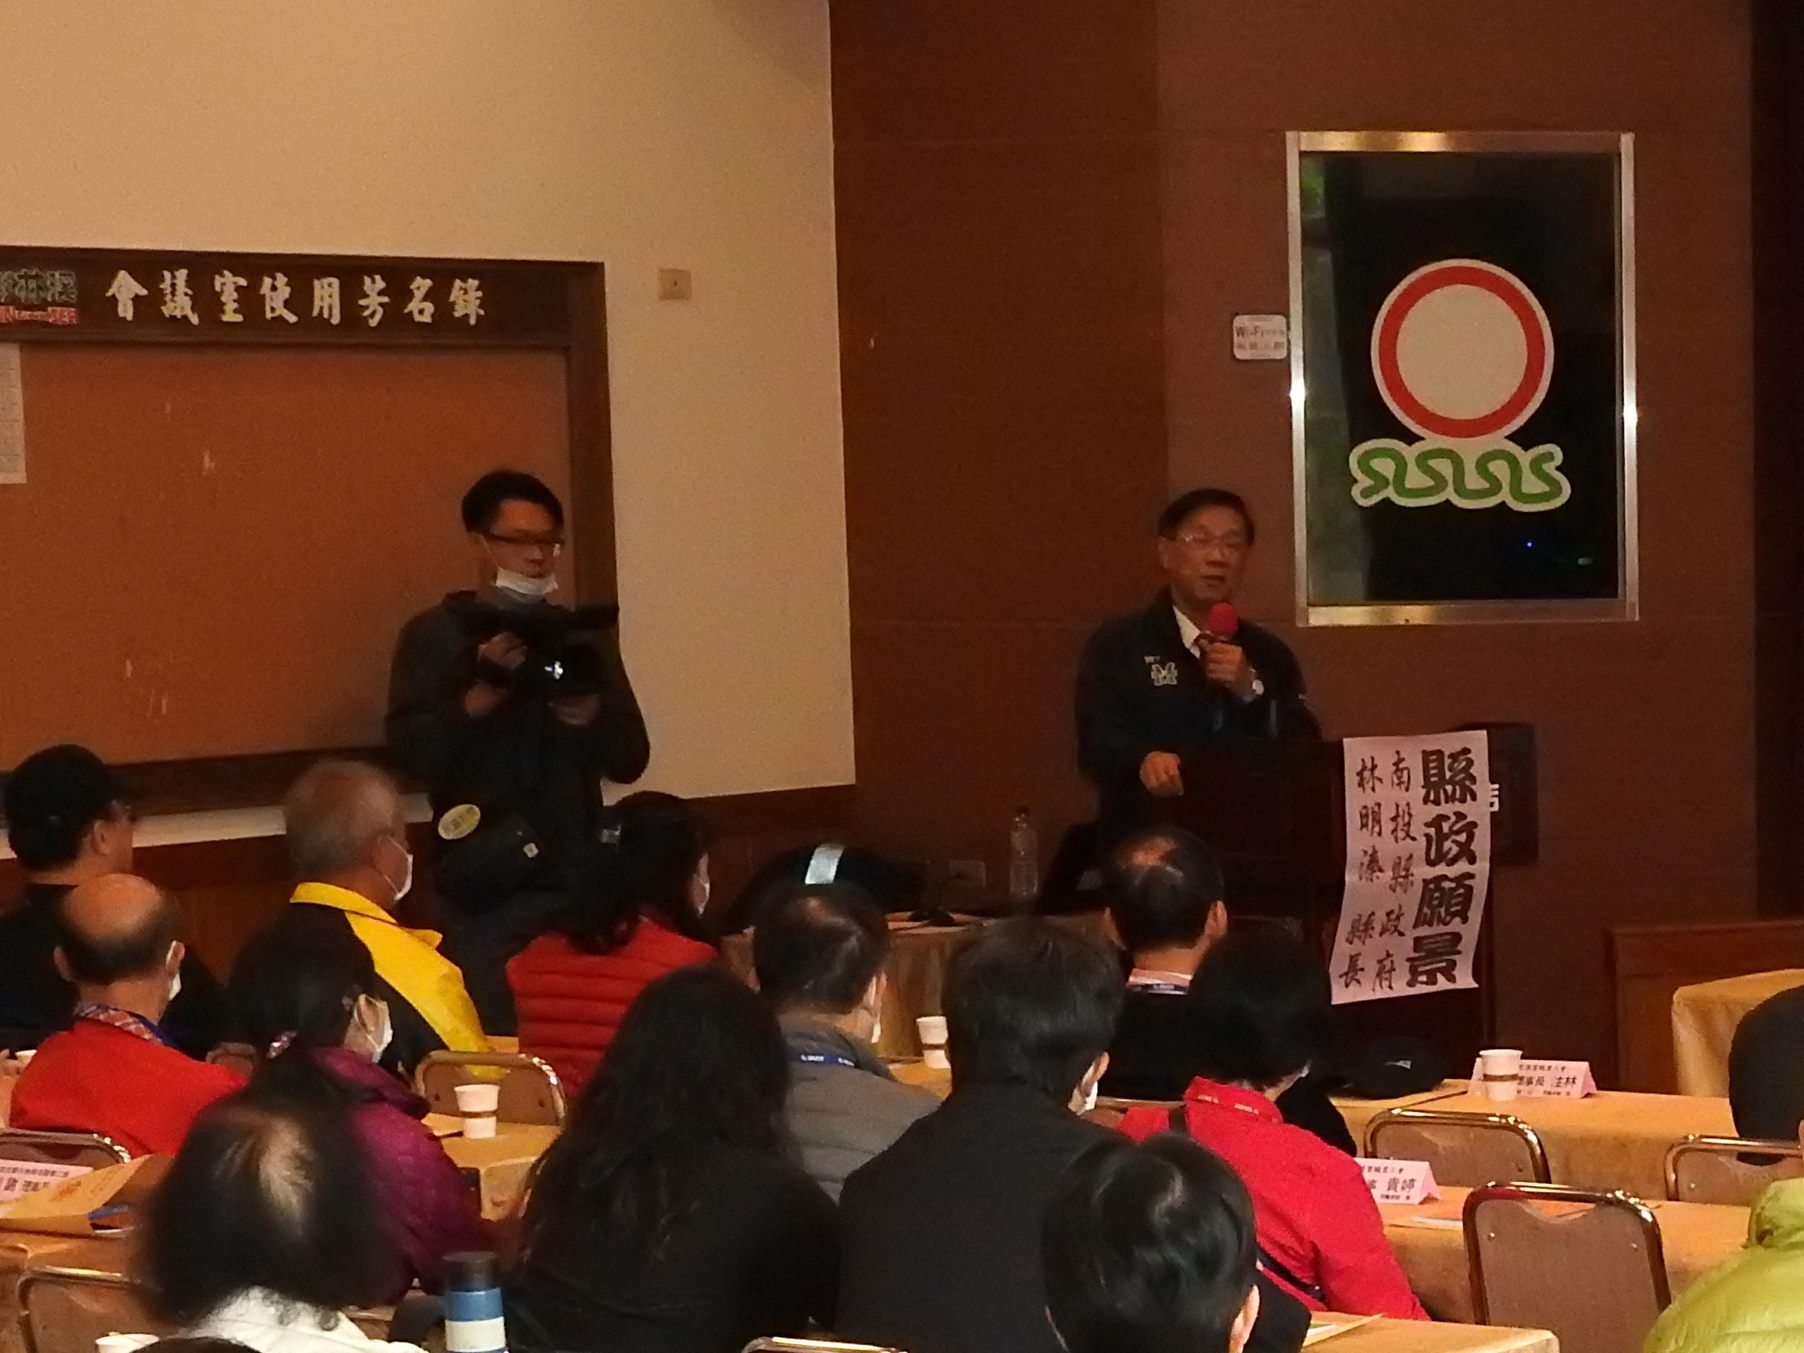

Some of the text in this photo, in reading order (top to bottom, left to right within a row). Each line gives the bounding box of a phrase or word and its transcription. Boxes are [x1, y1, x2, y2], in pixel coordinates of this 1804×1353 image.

[106, 269, 485, 326] 會議室使用芳名錄
[1372, 750, 1417, 992] 南投縣政府
[1406, 747, 1478, 987] 縣政願景
